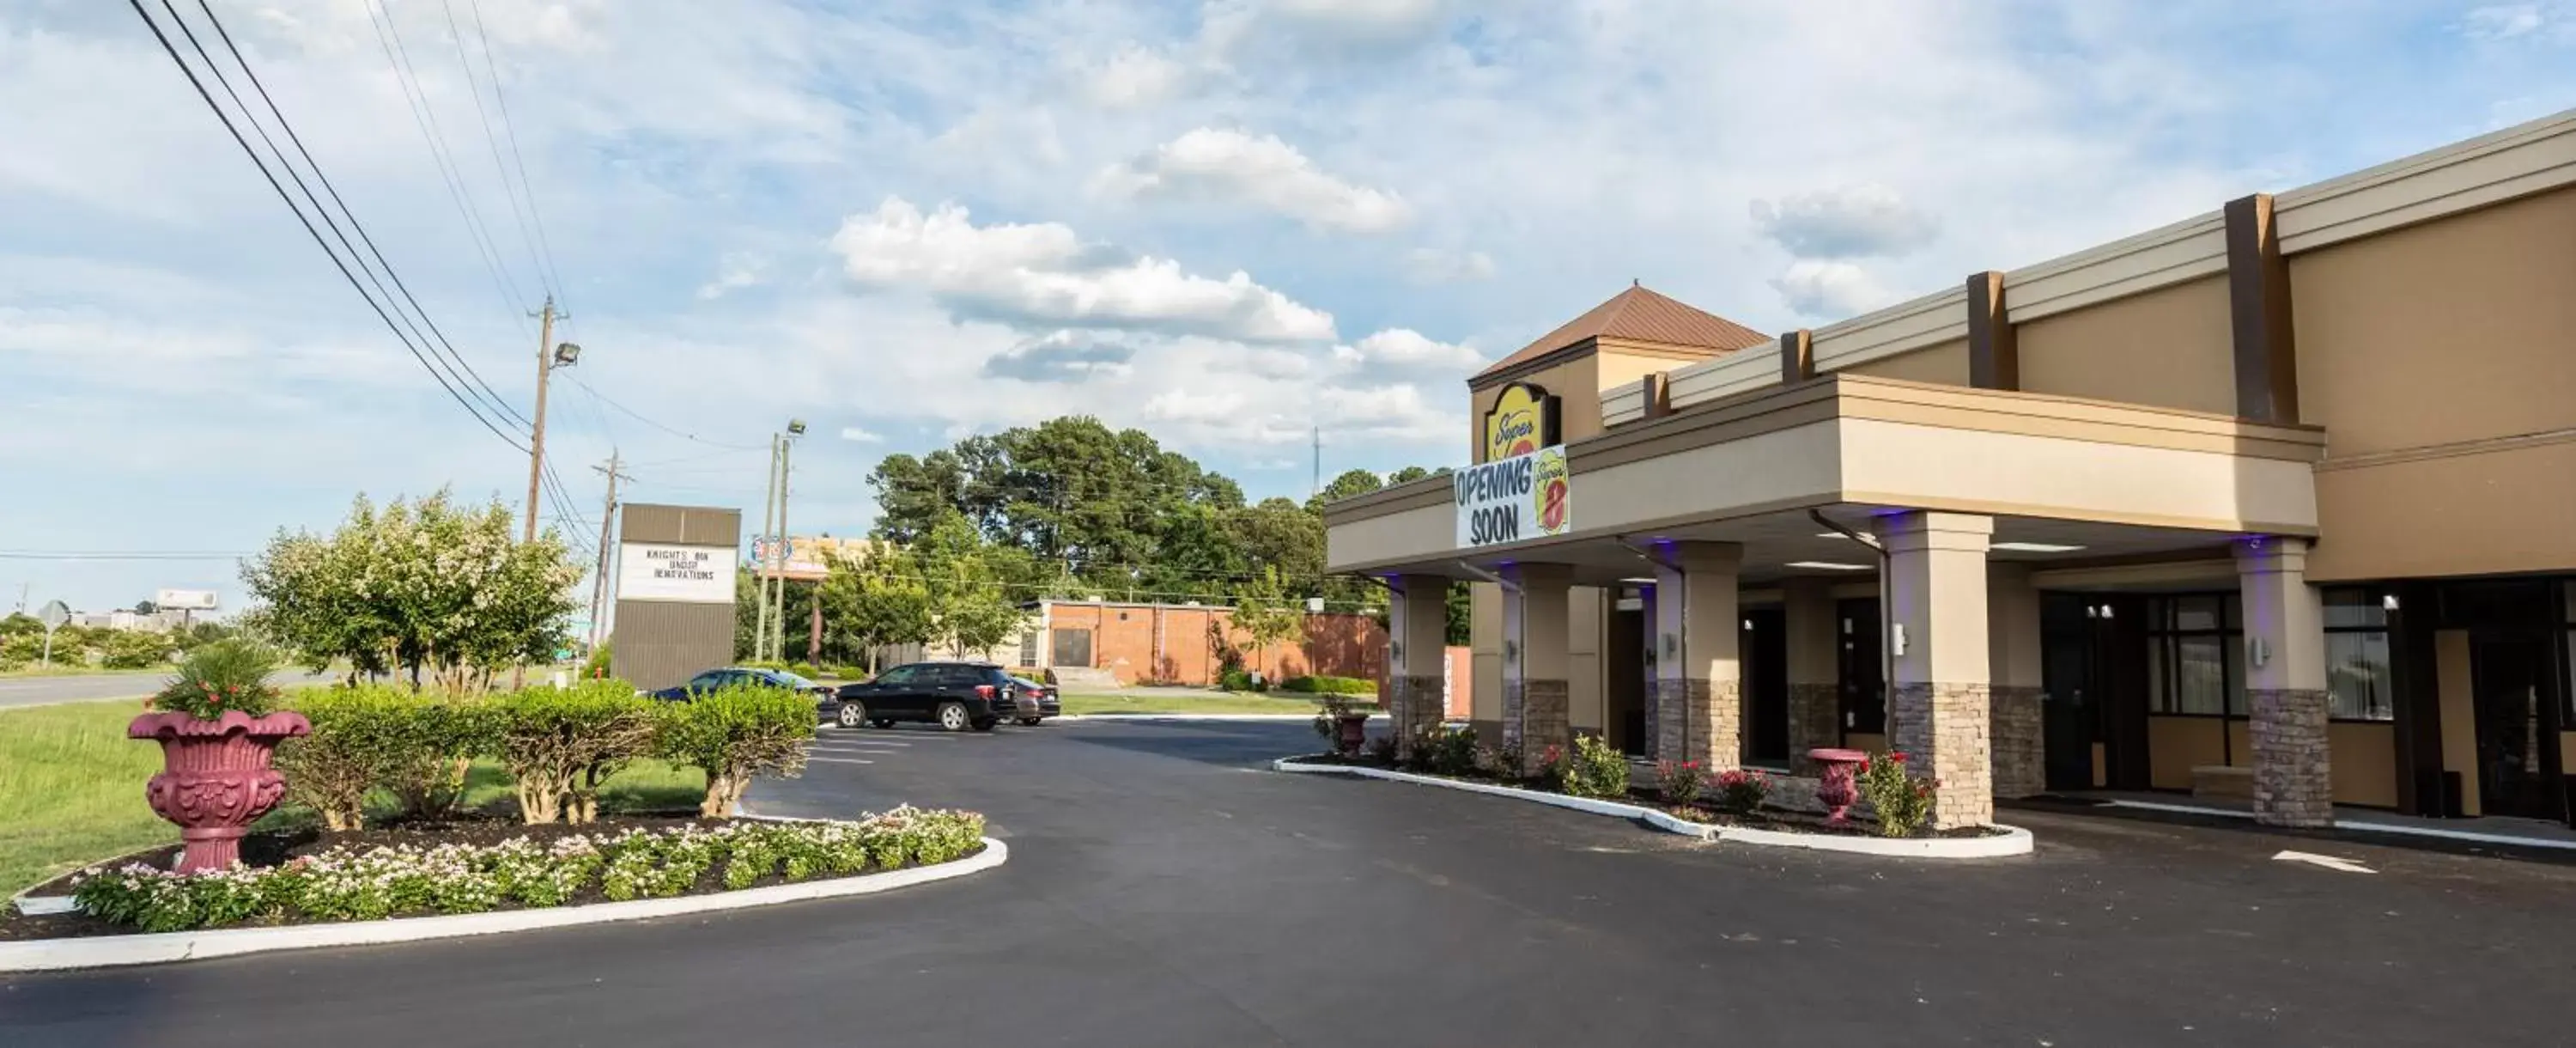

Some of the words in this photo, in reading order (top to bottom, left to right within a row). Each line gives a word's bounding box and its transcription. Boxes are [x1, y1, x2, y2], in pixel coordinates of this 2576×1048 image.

[1495, 409, 1534, 457] Super
[1456, 457, 1532, 506] OPENING
[1471, 503, 1519, 545] SOON
[1543, 480, 1566, 529] 8
[647, 550, 688, 560] KNIGHTS
[654, 569, 714, 580] RENOVATIONS
[669, 561, 698, 570] UNDER
